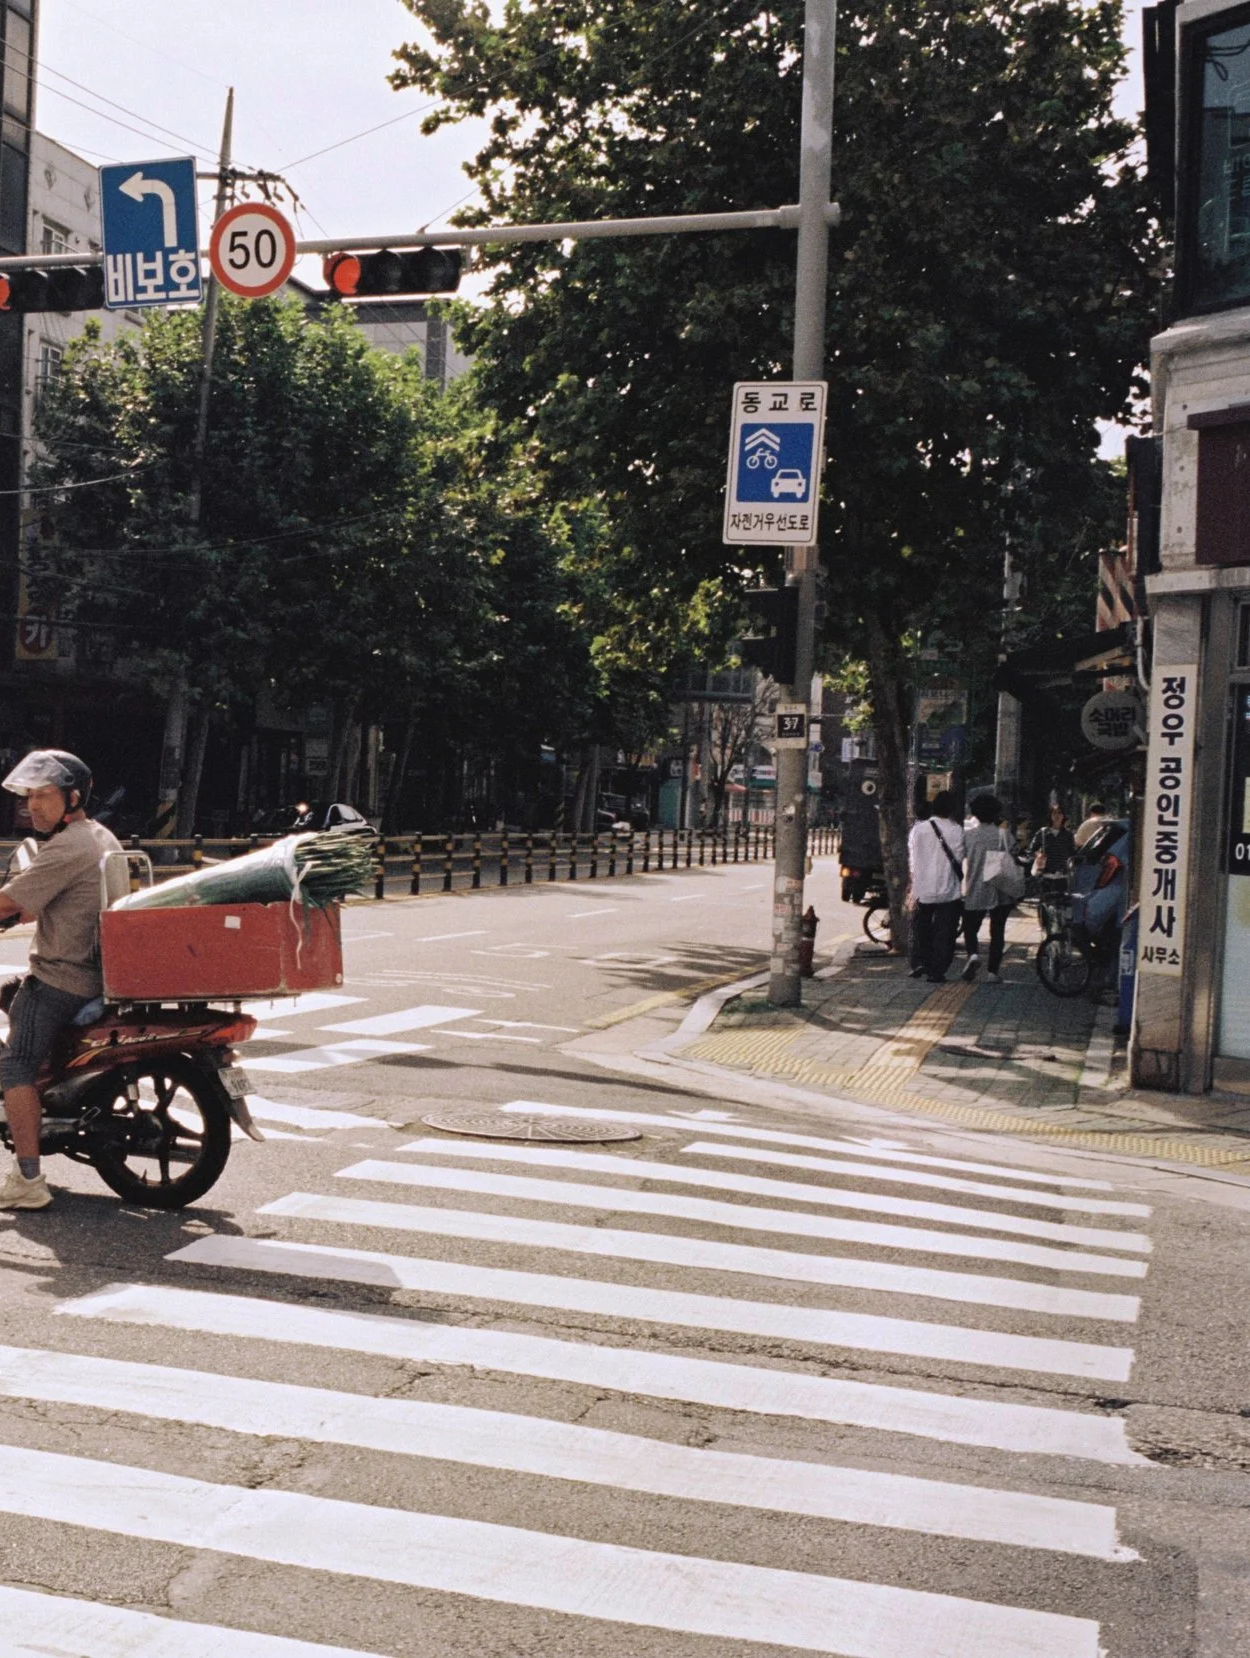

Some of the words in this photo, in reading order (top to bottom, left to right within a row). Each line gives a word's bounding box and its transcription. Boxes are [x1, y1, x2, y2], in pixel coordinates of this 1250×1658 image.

[228, 228, 277, 270] 50
[107, 249, 199, 302] 비보호
[741, 391, 817, 413] 동교로
[730, 512, 809, 531] 자전거우선도로
[782, 717, 799, 730] 37
[1160, 677, 1186, 746] 정우
[1150, 757, 1182, 938] 공인중개사
[1140, 945, 1180, 965] 사무소
